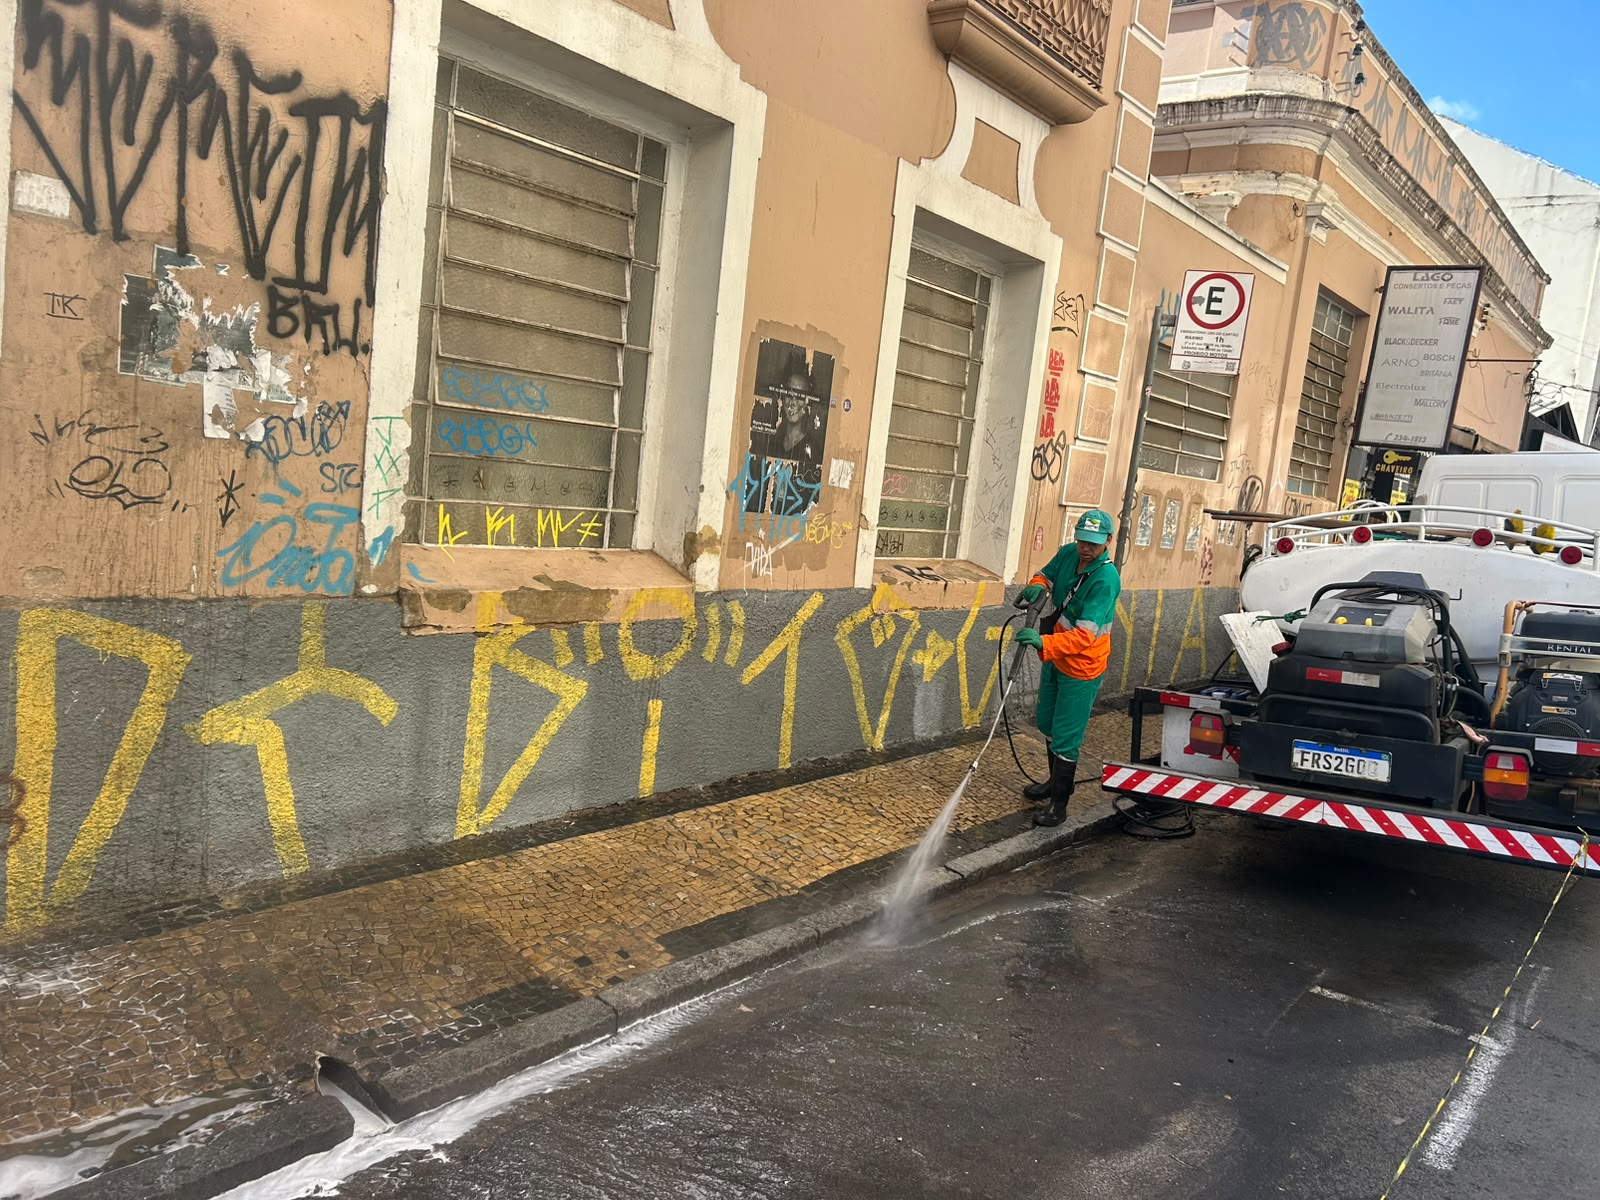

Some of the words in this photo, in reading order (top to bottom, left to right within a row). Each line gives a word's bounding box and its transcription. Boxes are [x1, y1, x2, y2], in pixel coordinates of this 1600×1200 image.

[1412, 271, 1454, 282] LAGO
[1393, 282, 1438, 290] CONSERTOS
[1445, 282, 1472, 290] PEÇAS
[1205, 286, 1225, 315] E
[1387, 306, 1435, 316] WALITA
[1422, 353, 1456, 362] BOSCH
[1380, 358, 1420, 368] ARNO
[1375, 382, 1427, 391] Electrolux
[1375, 463, 1414, 474] CHAVEIRO
